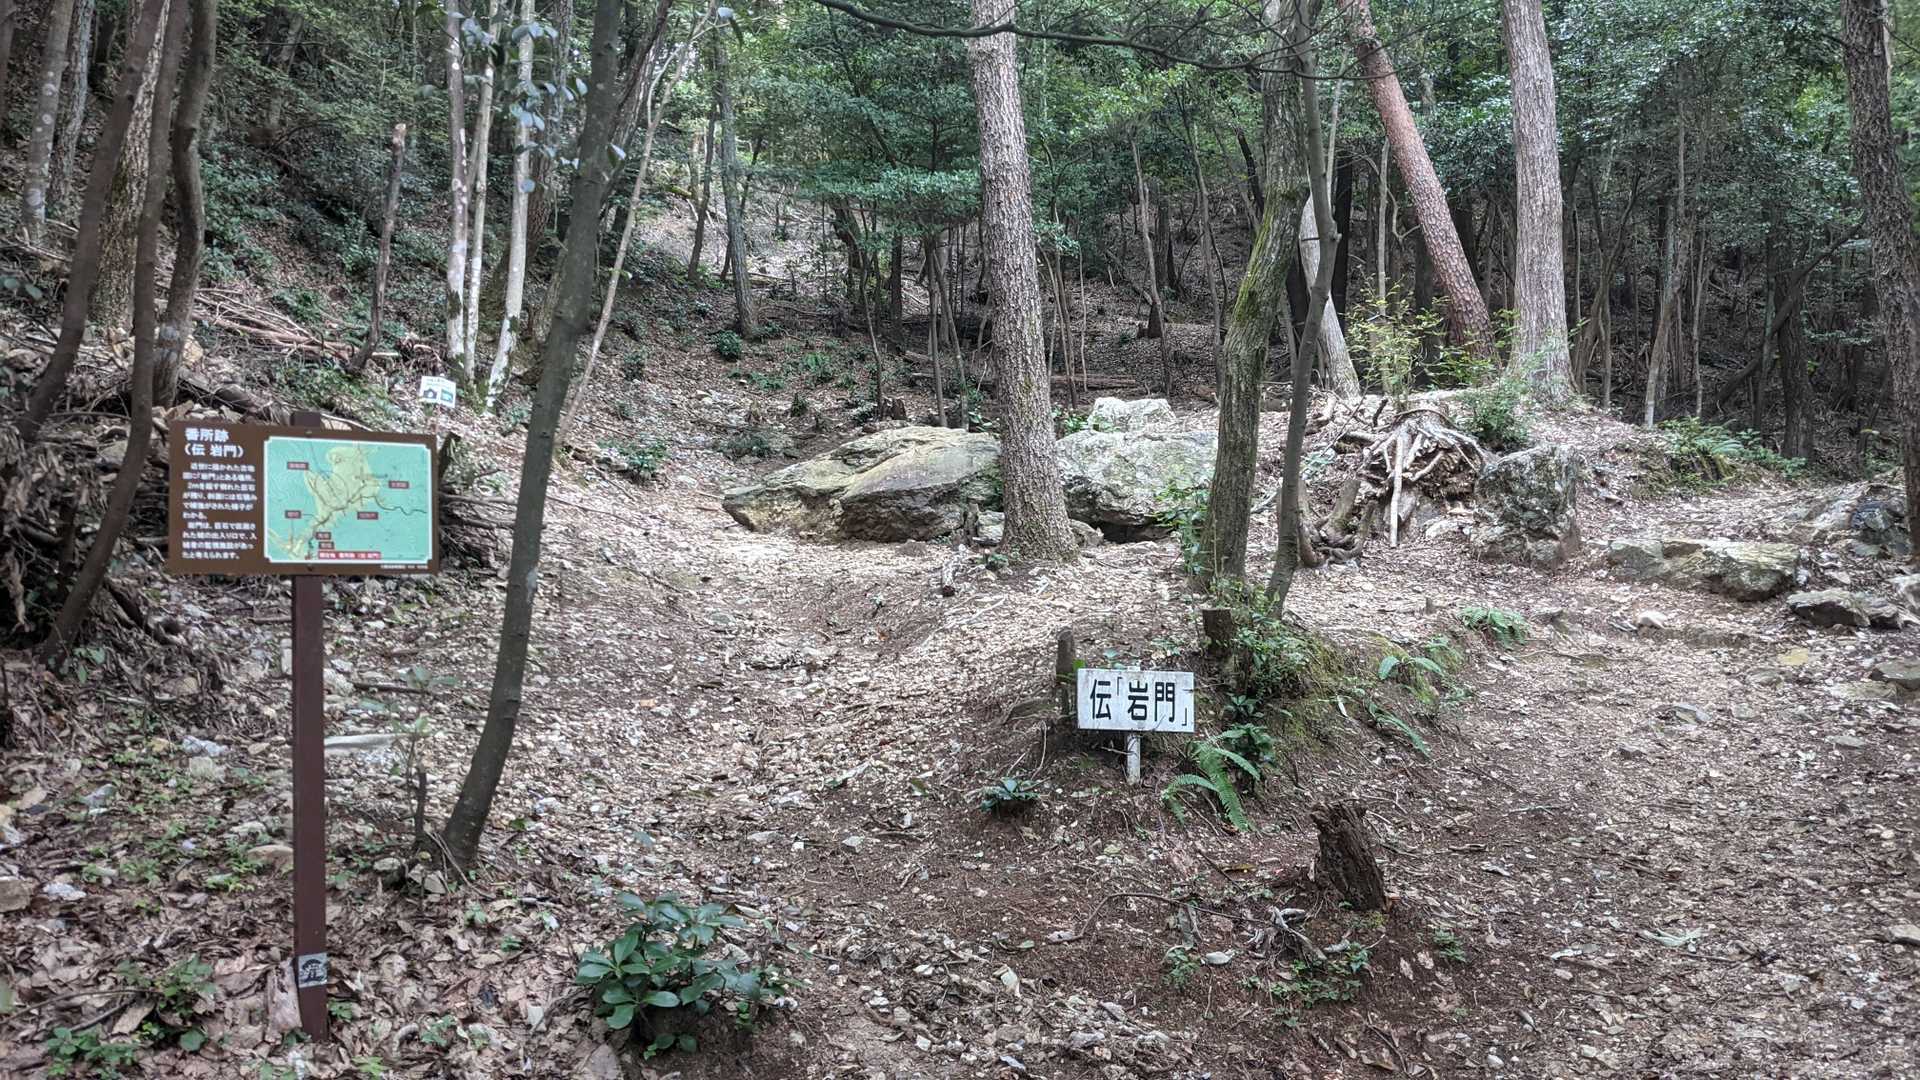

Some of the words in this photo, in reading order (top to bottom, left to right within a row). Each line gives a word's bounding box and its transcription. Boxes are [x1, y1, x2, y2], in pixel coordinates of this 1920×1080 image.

[185, 428, 229, 442] 番所跡
[1090, 676, 1188, 726] 伝「岩門」
